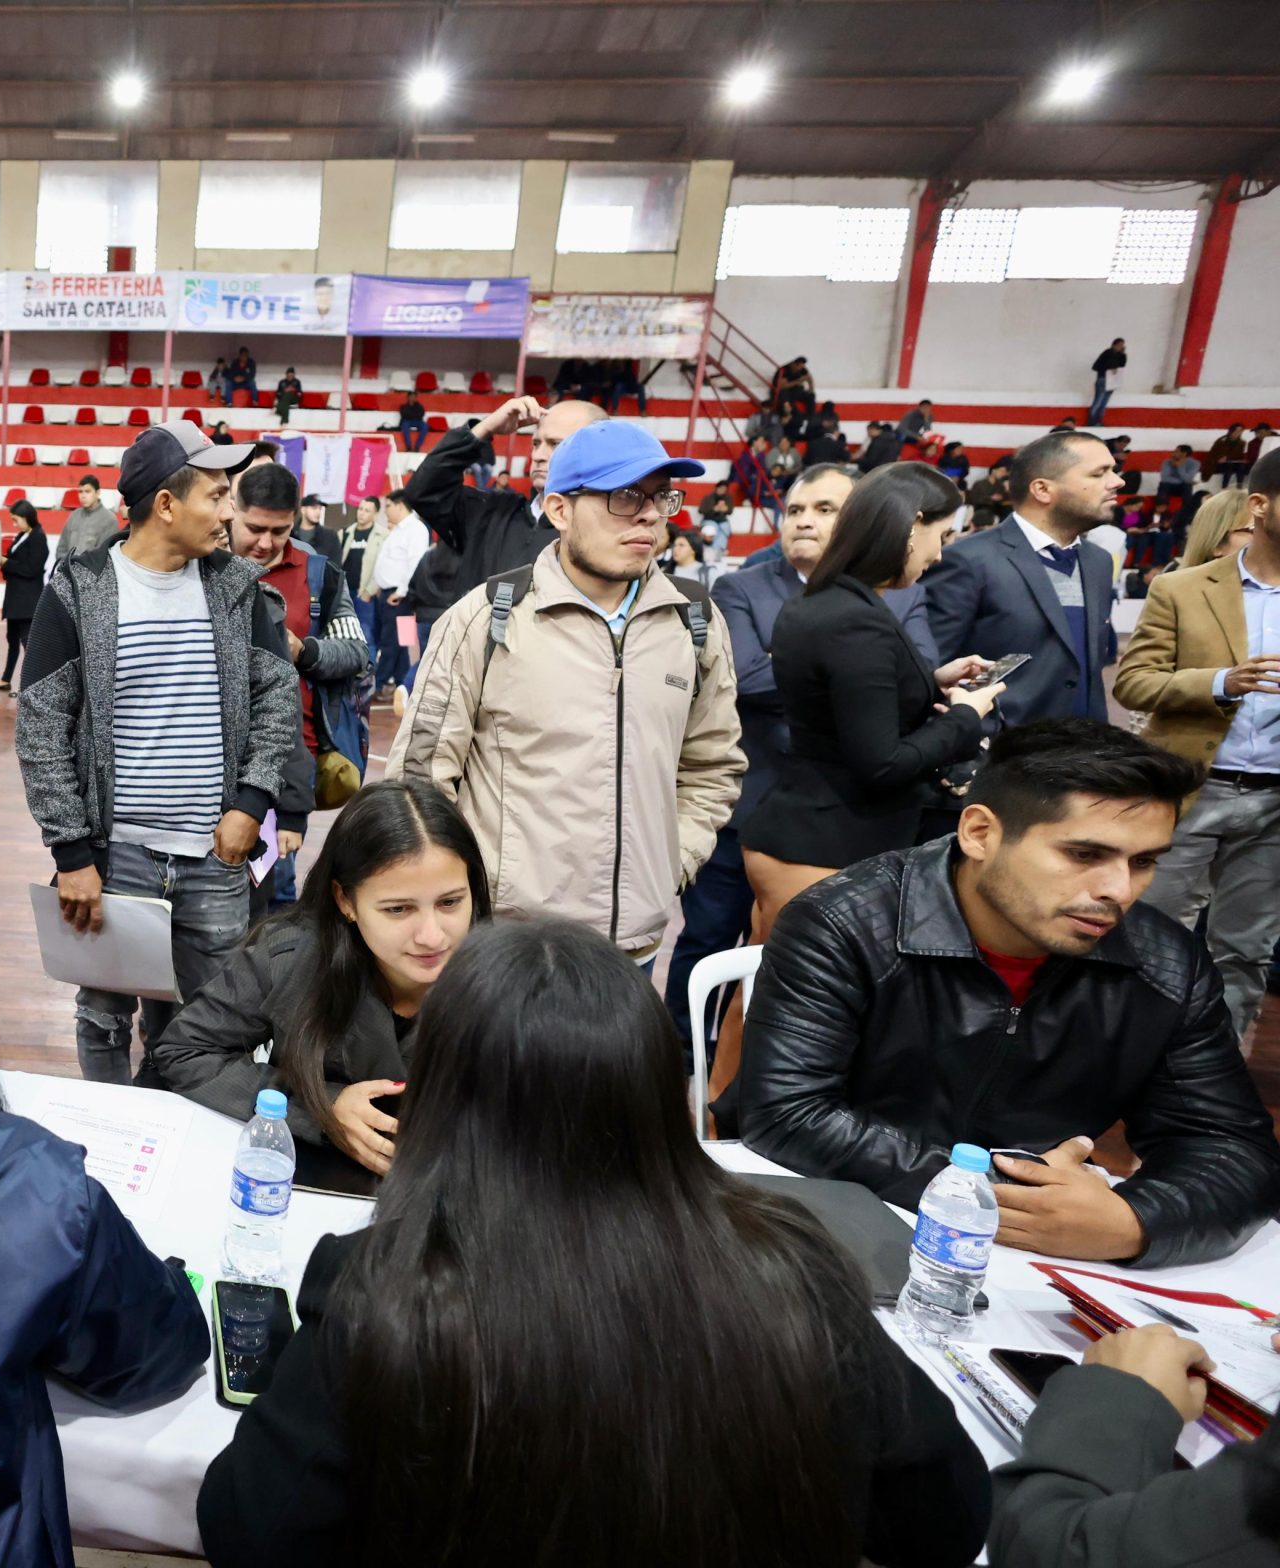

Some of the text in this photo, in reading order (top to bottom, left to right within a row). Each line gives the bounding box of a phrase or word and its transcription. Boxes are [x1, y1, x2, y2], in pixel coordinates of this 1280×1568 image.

[51, 275, 165, 297] FERRETERIA
[221, 279, 262, 293] LO DE
[23, 301, 167, 318] SANTA CATALINA
[221, 294, 302, 321] TOTE
